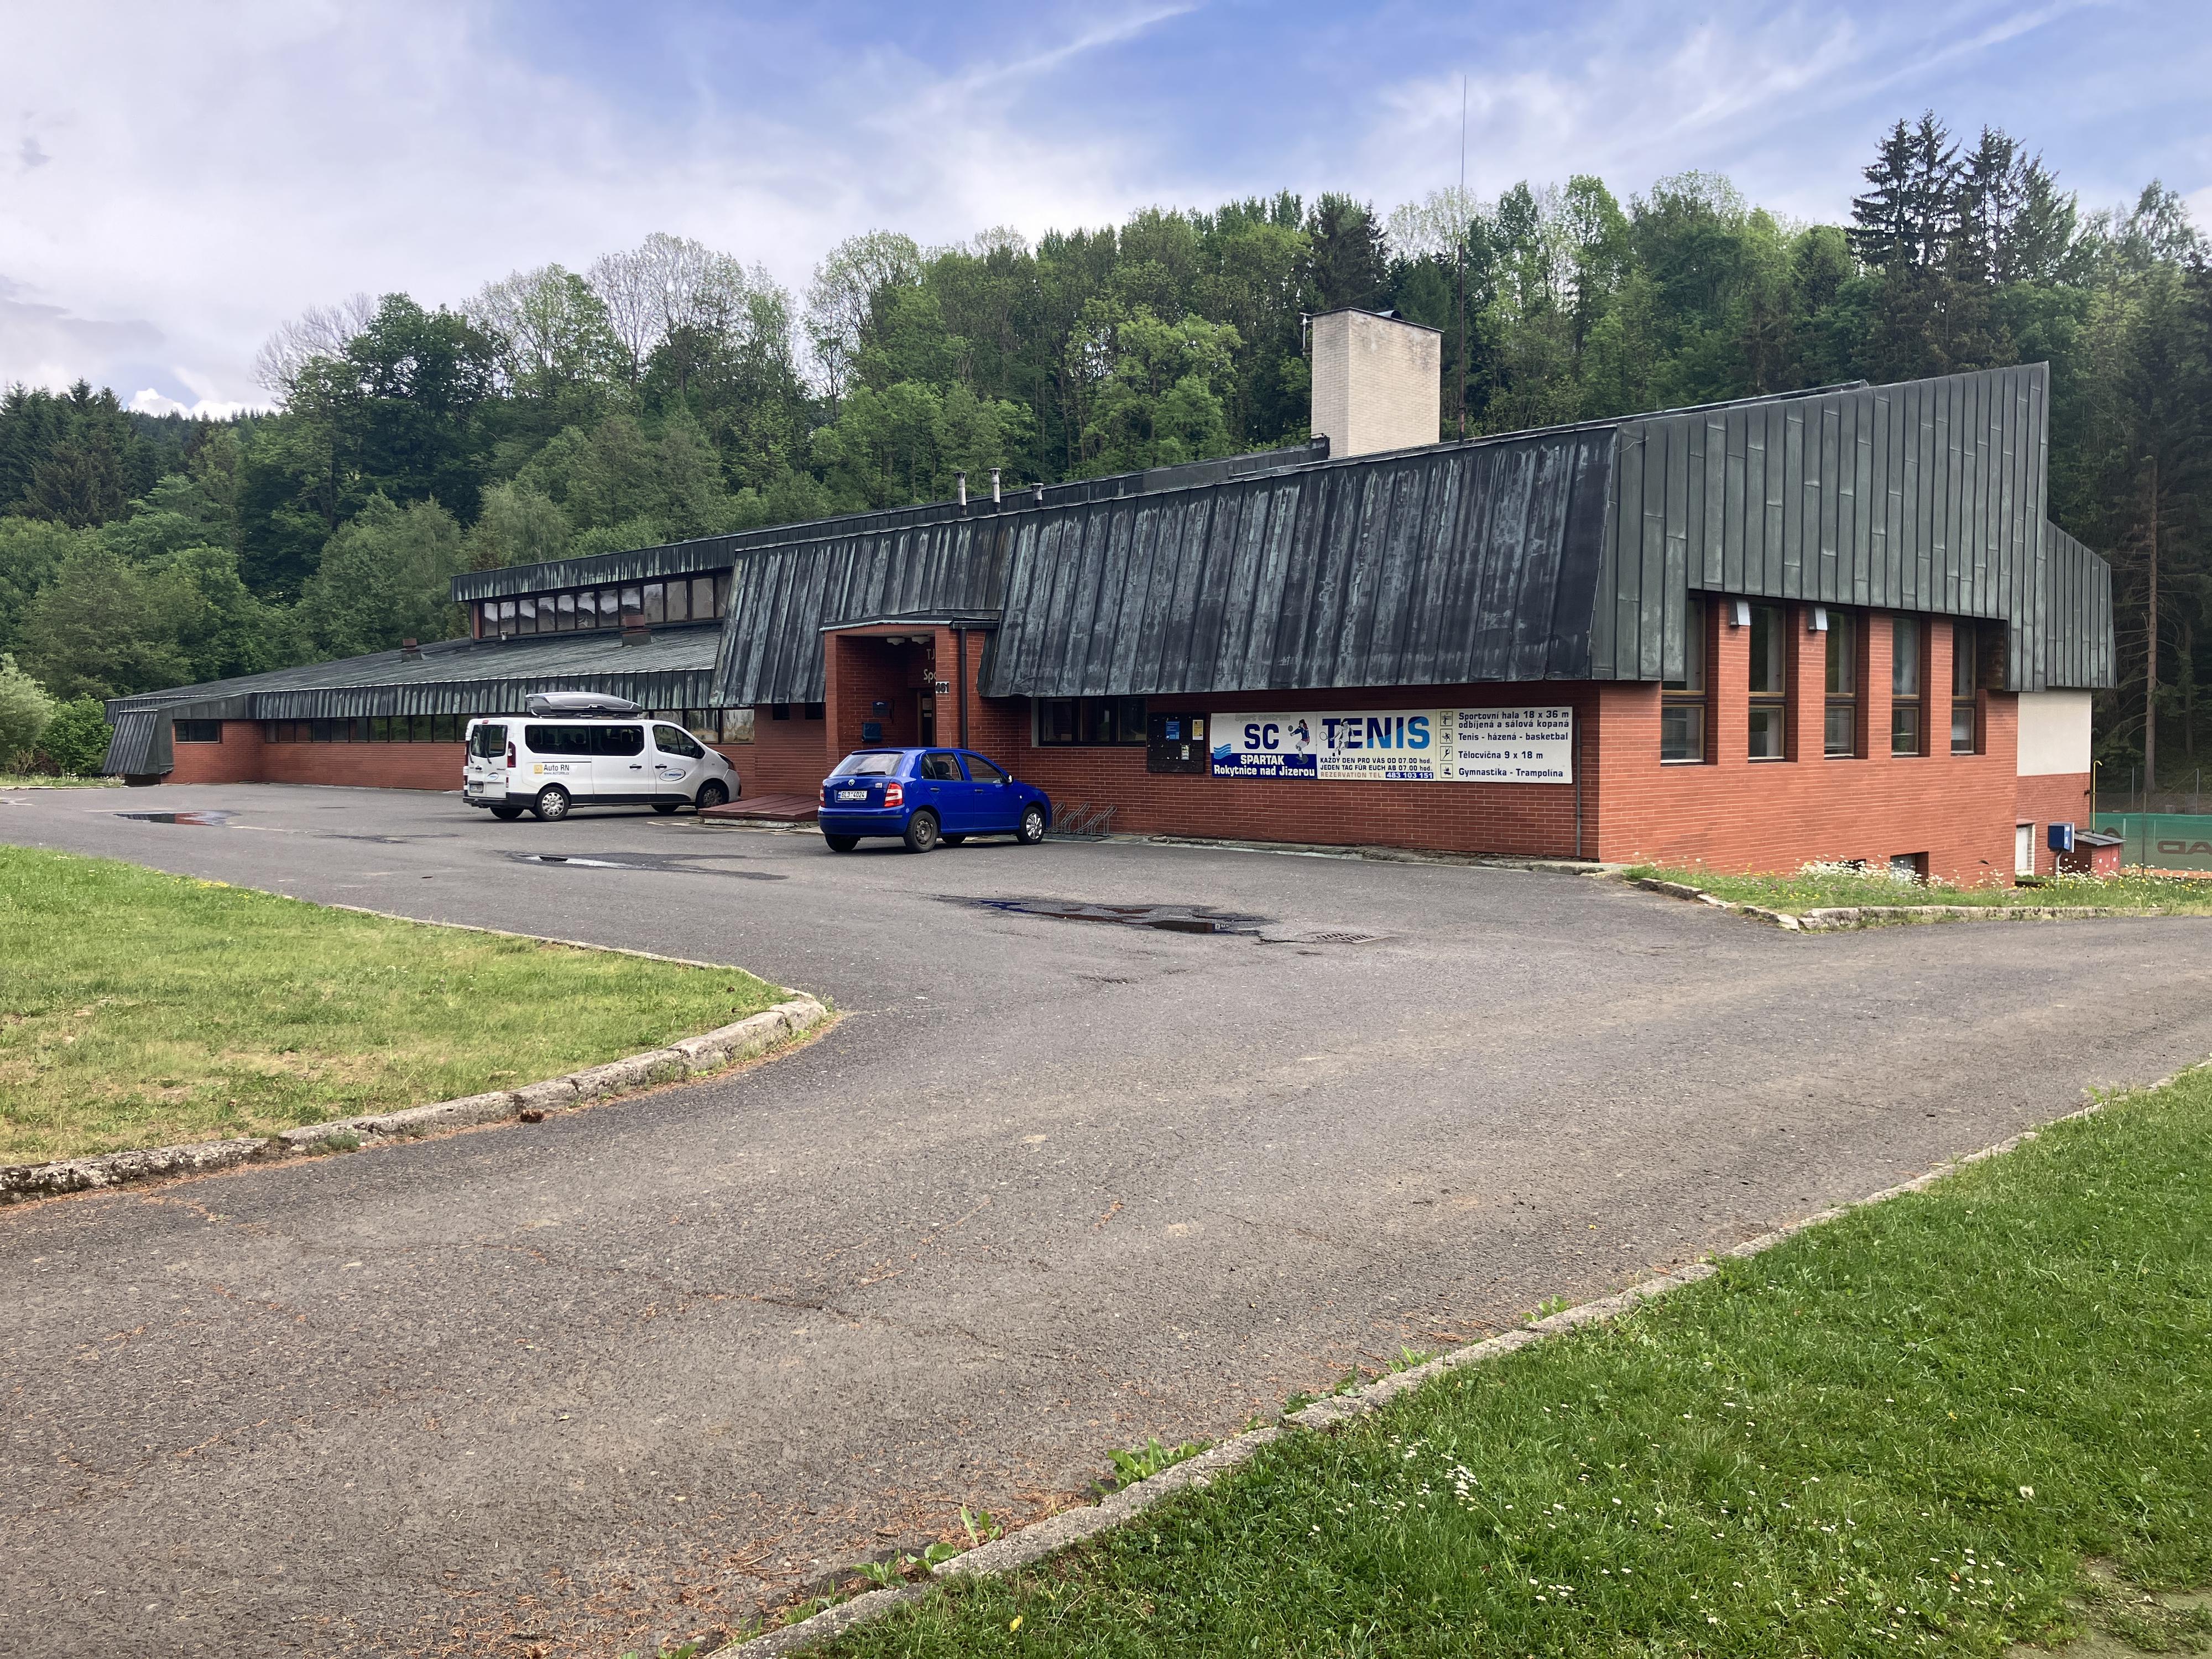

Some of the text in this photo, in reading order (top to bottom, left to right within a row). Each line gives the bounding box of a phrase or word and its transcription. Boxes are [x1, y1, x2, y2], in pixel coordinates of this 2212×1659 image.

[926, 649, 935, 660] TJ
[1459, 711, 1499, 721] Sportovní
[1546, 710, 1558, 718] 36
[1459, 720, 1494, 729] odbíjená
[1537, 719, 1569, 729] kopaná
[1244, 723, 1279, 749] SC
[1322, 716, 1430, 749] TENIS
[1488, 732, 1516, 740] házená
[1526, 732, 1568, 740] basketbal
[1458, 750, 1501, 759] Tělocvična
[1240, 755, 1285, 765] SPARTAK
[1214, 764, 1315, 776] Rokytnice nad Jizerou
[1459, 768, 1507, 777] Gymnastika
[1516, 768, 1563, 778] Trampolína
